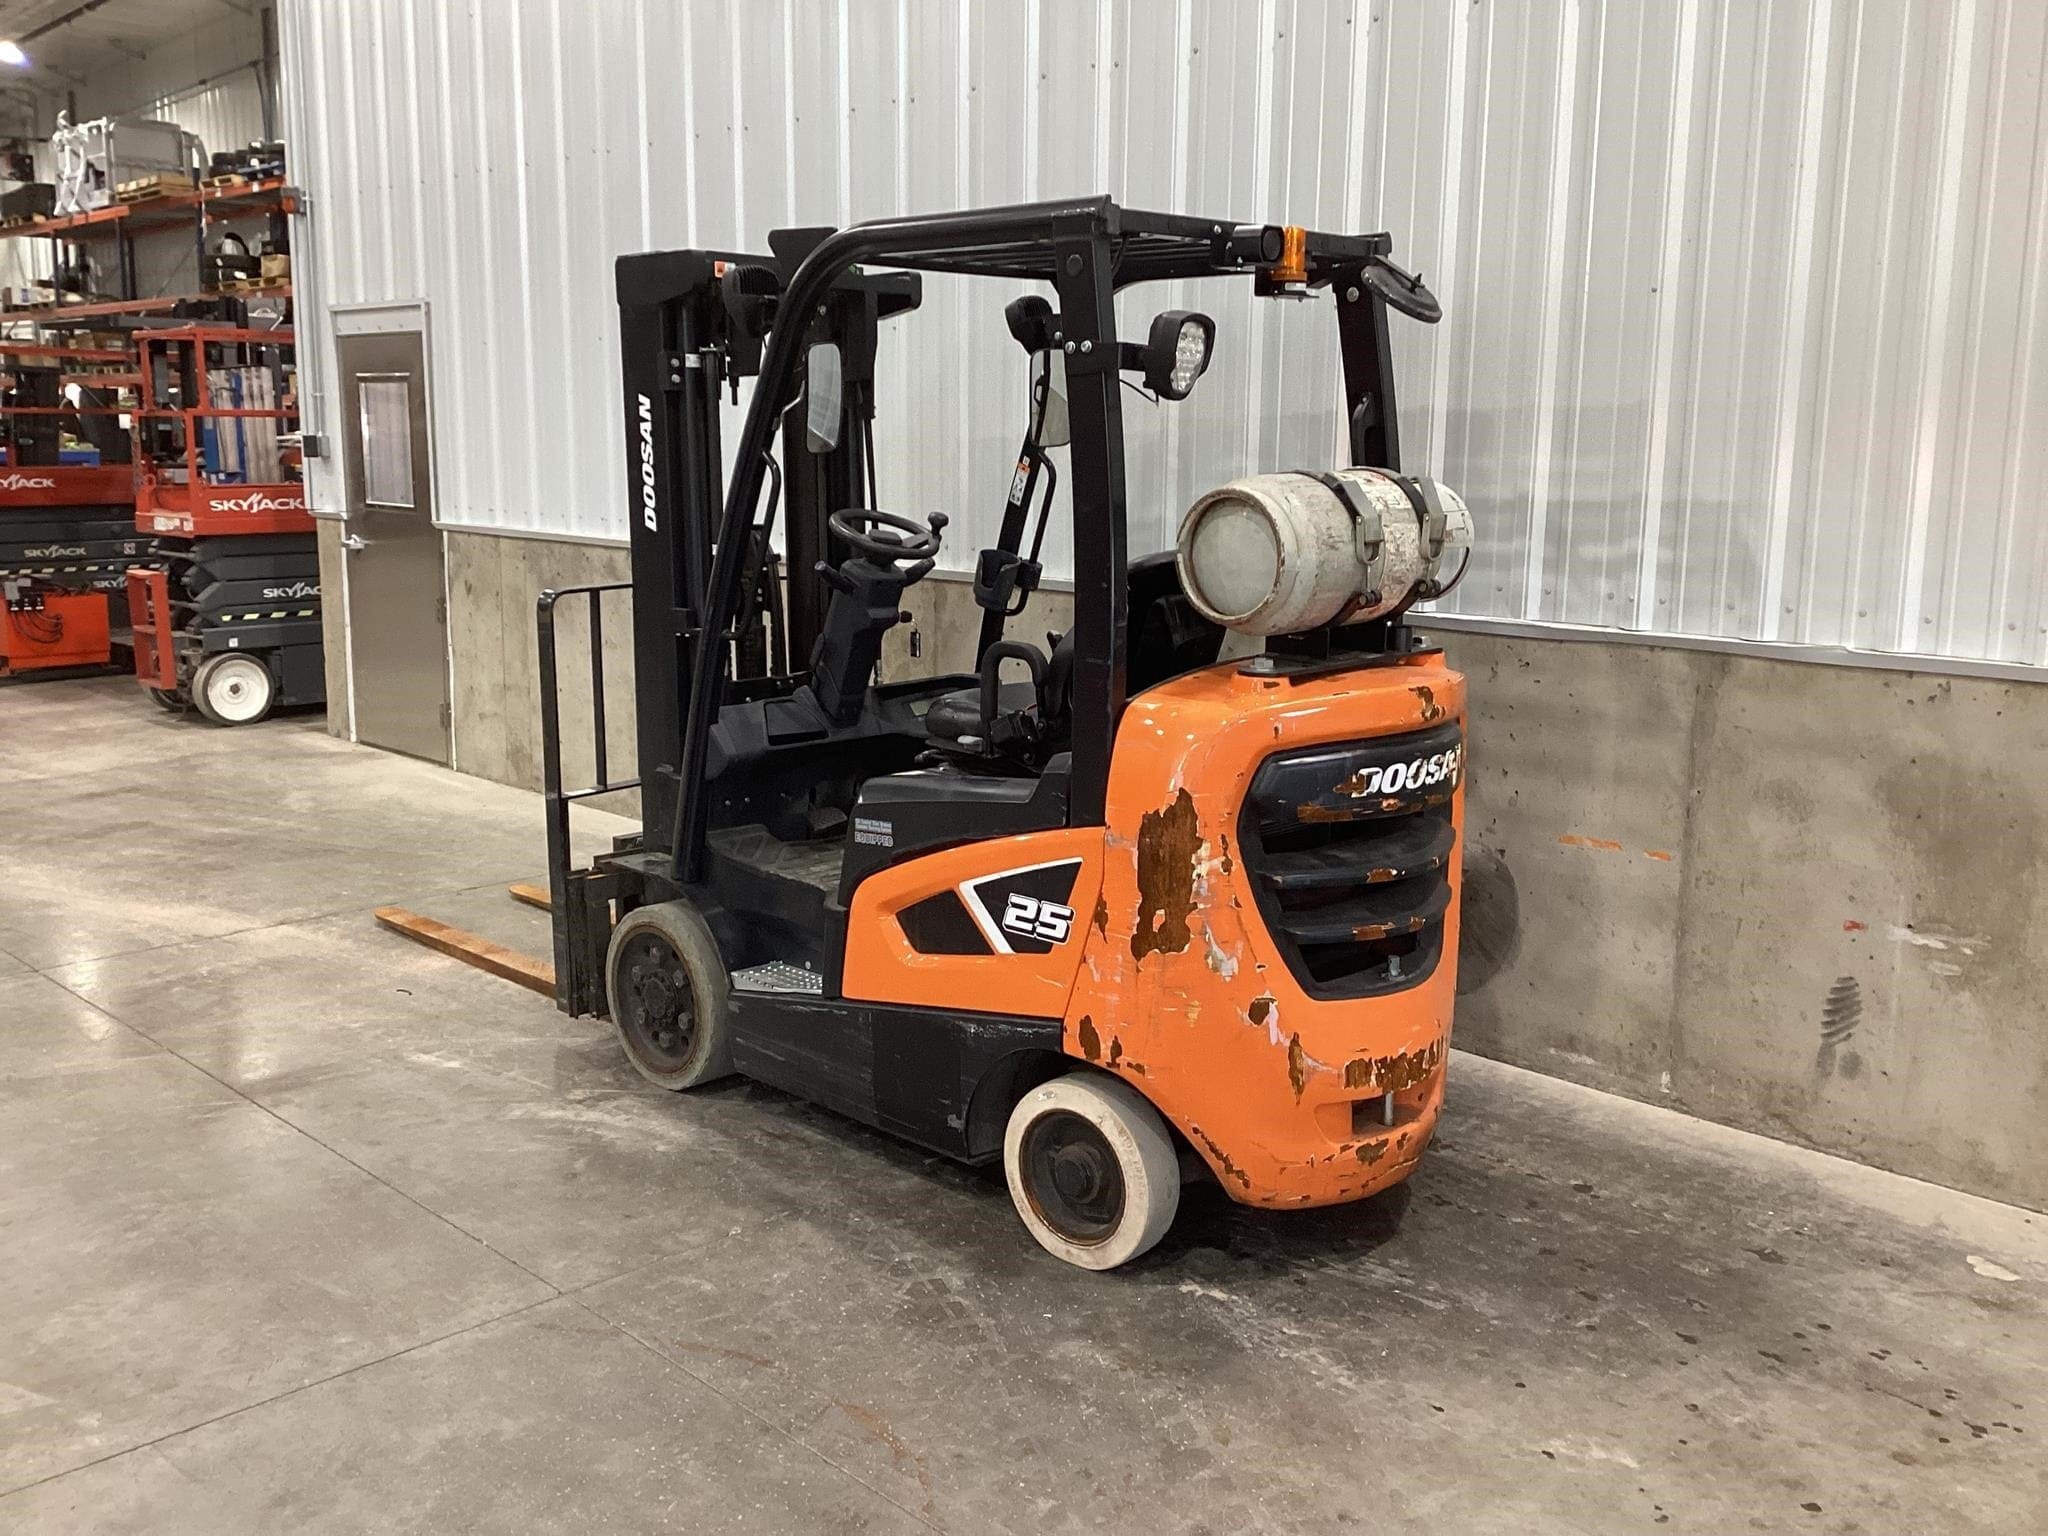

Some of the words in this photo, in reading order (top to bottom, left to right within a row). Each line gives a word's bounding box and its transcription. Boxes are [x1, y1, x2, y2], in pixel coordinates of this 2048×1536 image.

[638, 393, 657, 532] DOOSAN
[209, 493, 308, 513] SKYJACK
[24, 545, 87, 558] SKYJACK
[1002, 893, 1076, 945] 25
